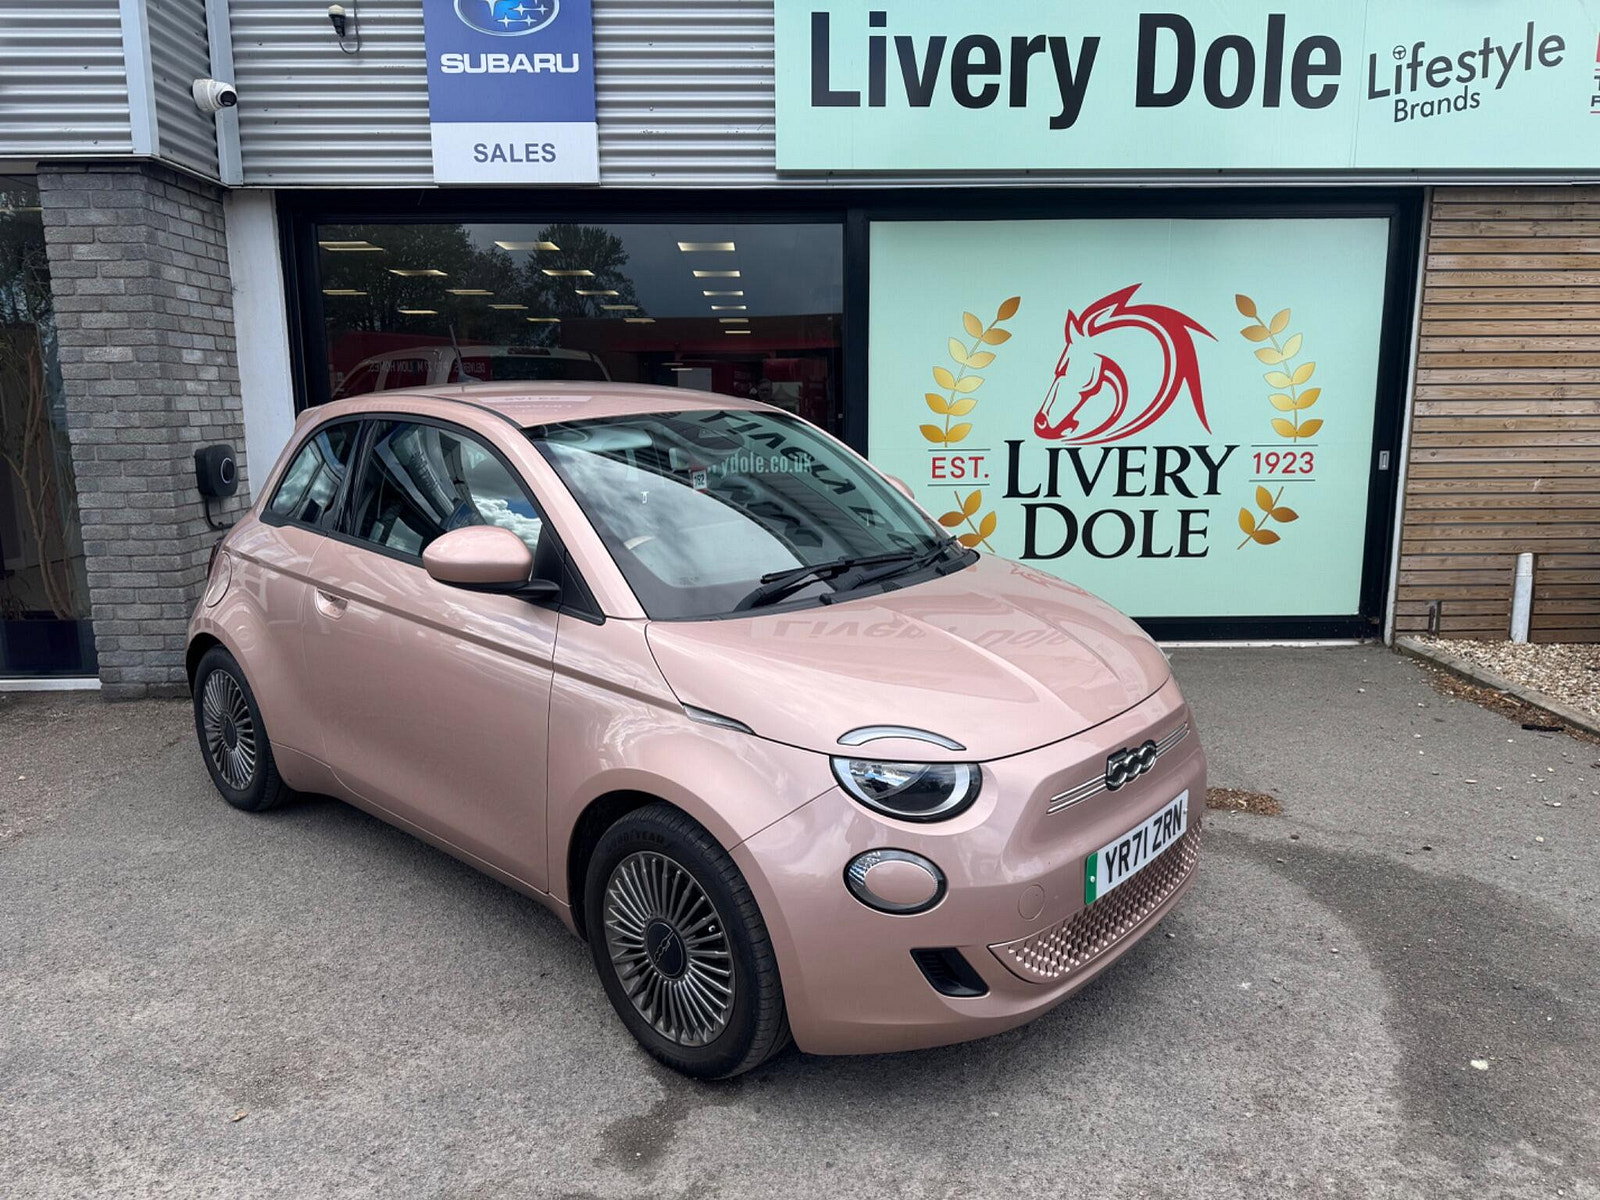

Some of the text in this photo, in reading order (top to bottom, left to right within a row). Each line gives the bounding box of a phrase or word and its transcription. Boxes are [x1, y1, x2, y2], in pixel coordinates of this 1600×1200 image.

[440, 53, 579, 74] SUBARU
[811, 11, 1342, 130] Livery Dole
[1367, 21, 1566, 100] Lifestyle
[1394, 85, 1481, 122] Brands
[473, 143, 557, 163] SALES
[931, 456, 990, 479] EST.
[1002, 440, 1240, 499] LIVERY
[1252, 451, 1315, 475] 1923
[1019, 502, 1211, 560] DOLE
[1106, 740, 1157, 791] 500
[1105, 799, 1183, 883] YR71 ZRN
